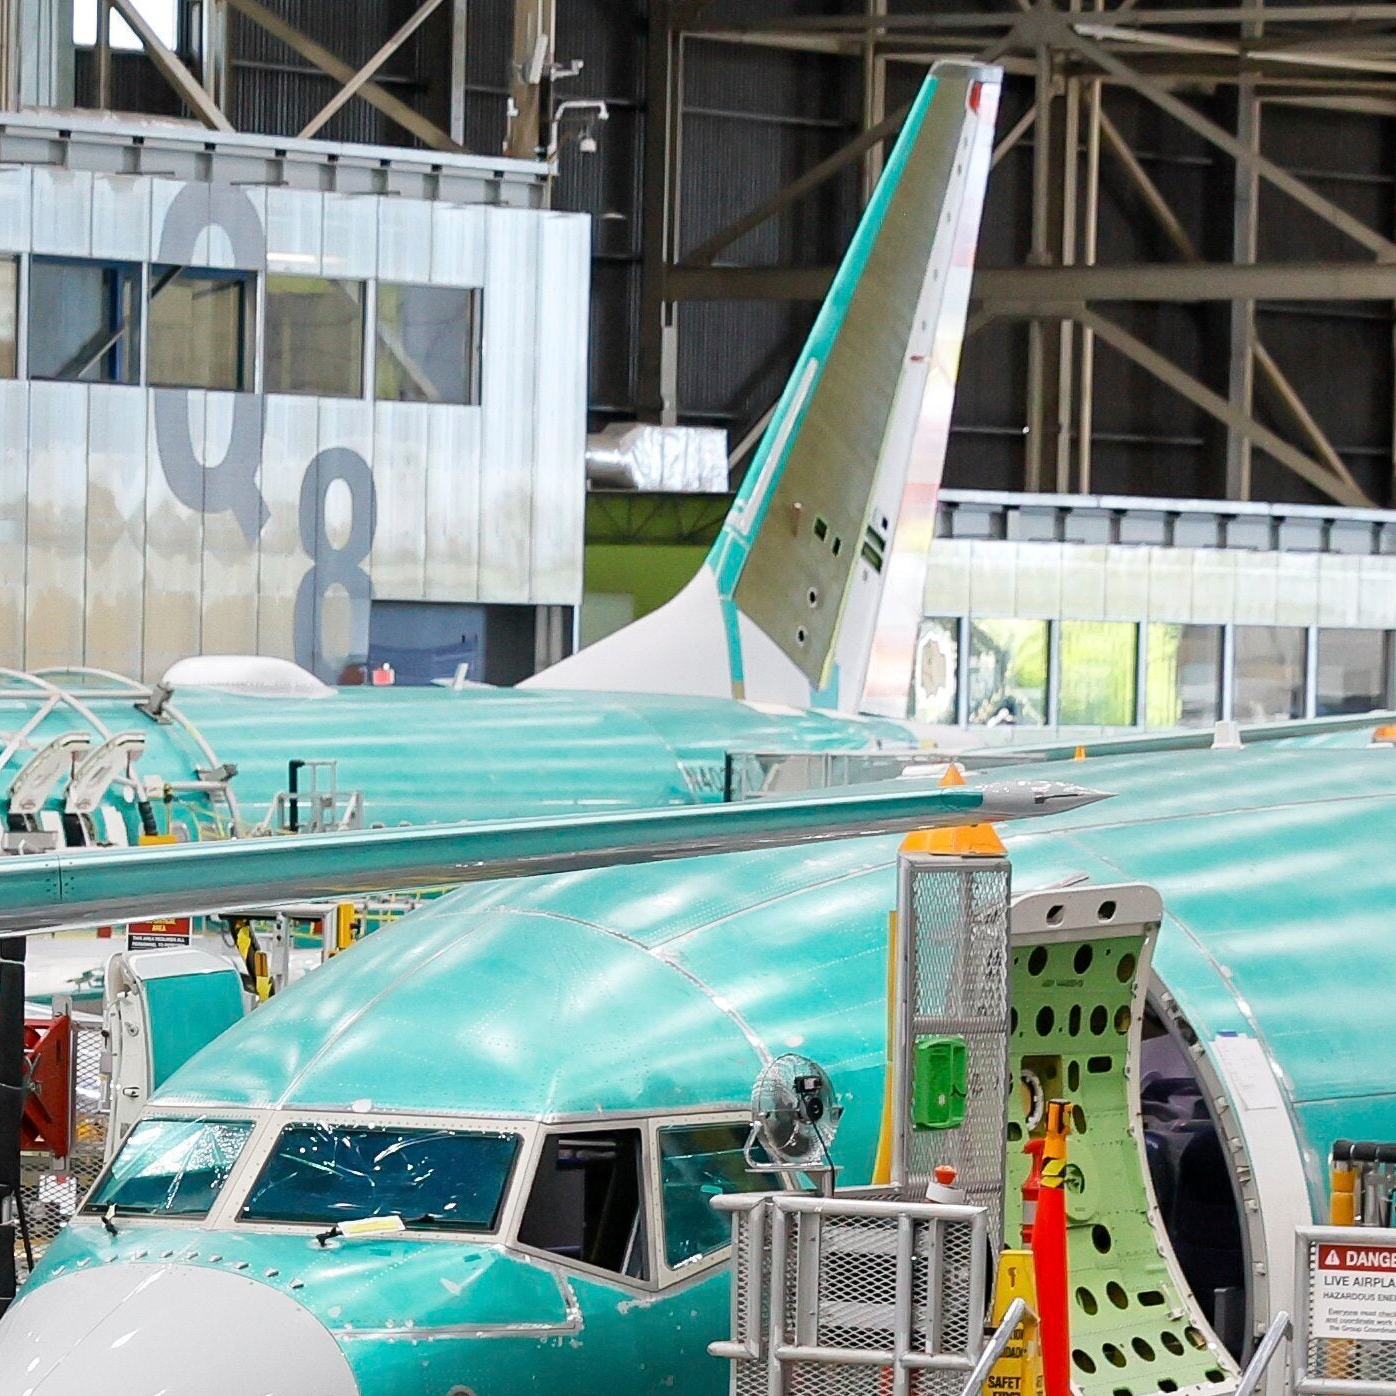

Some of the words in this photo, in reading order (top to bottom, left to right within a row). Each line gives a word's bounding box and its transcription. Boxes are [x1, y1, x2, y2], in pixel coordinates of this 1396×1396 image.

[1324, 1275, 1349, 1286] LIVE
[1323, 1291, 1376, 1302] HAZARDOUS
[988, 1375, 1021, 1390] SAFET
